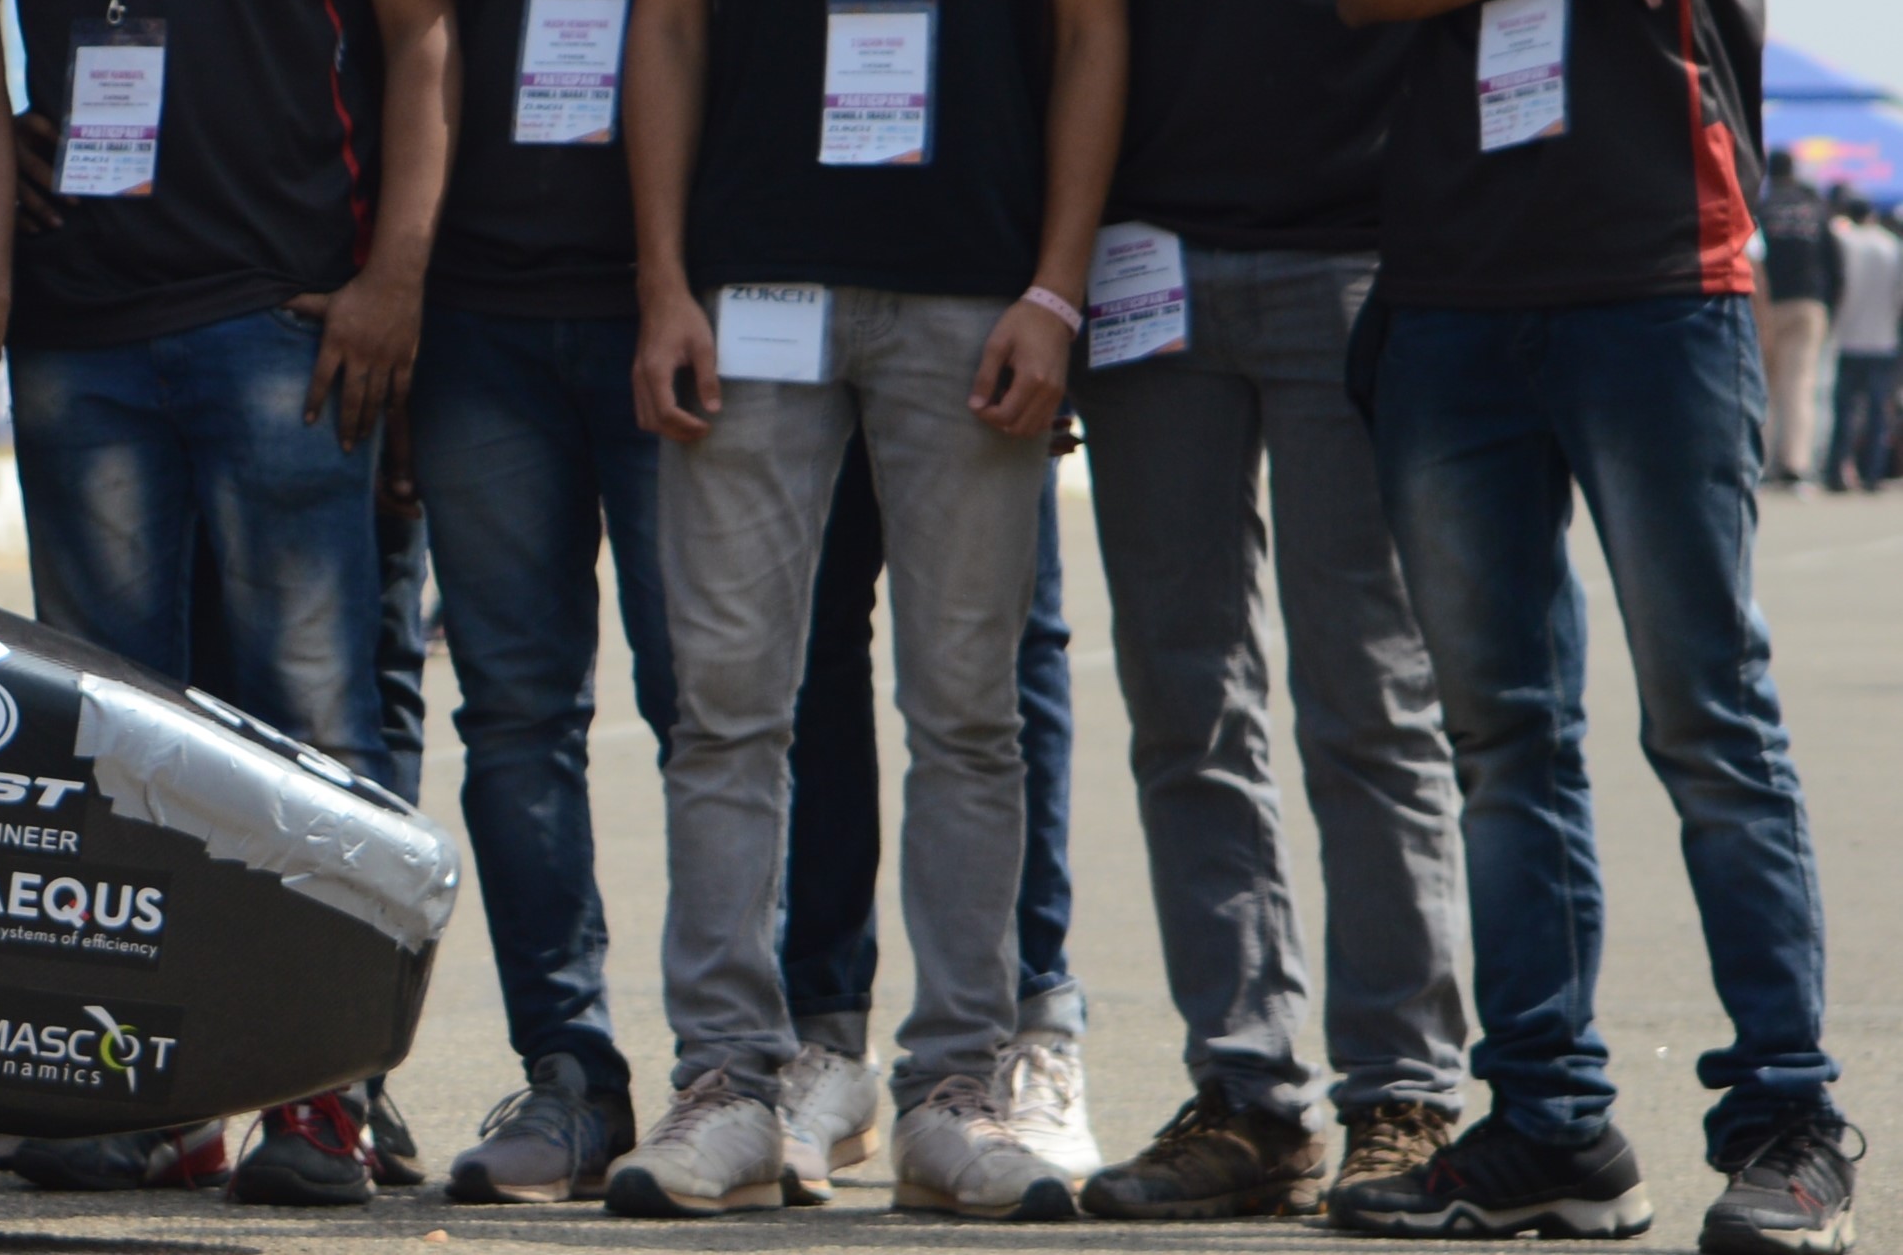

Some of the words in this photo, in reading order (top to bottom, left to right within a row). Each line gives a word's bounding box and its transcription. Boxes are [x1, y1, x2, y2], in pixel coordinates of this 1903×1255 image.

[534, 73, 601, 86] PARTICIPANT
[838, 94, 910, 107] PARTICIPANT
[80, 125, 144, 139] PARTICIPANT
[728, 287, 816, 304] ZUKEN
[60, 930, 79, 946] of
[81, 933, 159, 958] efficiency
